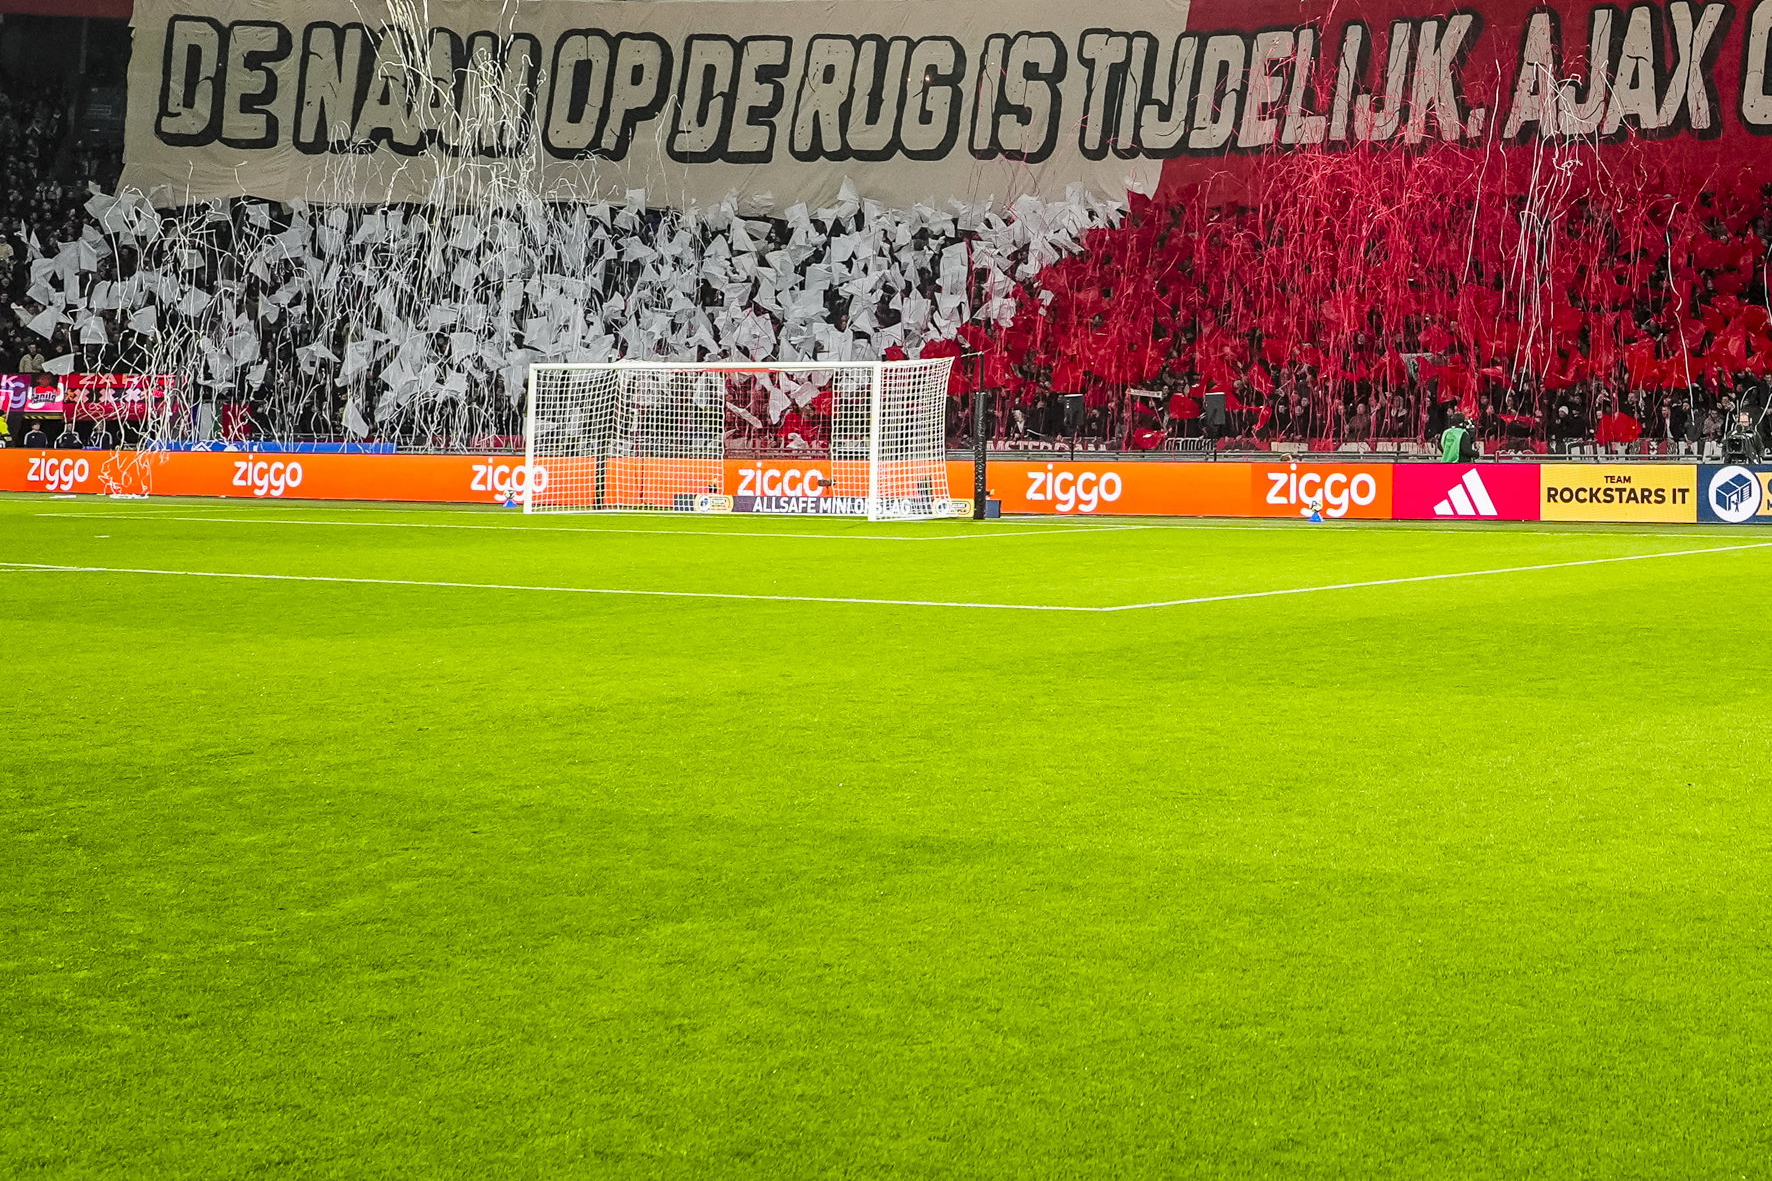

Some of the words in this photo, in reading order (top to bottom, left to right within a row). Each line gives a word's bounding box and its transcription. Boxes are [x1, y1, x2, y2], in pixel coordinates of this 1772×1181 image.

[154, 14, 292, 149] DE
[294, 21, 541, 158] NAAM
[544, 27, 672, 161] OP
[667, 33, 792, 163] DE
[789, 32, 967, 161] RUG
[968, 30, 1066, 163] IS
[1078, 8, 1488, 160] TIJDELIJK.
[27, 451, 90, 491] ziggo
[232, 455, 304, 496] ziggo
[737, 461, 824, 497] ziggo
[1026, 463, 1122, 513] ziggo
[1266, 462, 1376, 518] ziggo
[1604, 476, 1632, 484] TEAM
[753, 496, 817, 514] ALLSAFE
[819, 496, 851, 515] MINI
[1547, 487, 1666, 504] ROCKSTARS
[1671, 487, 1690, 504] IT
